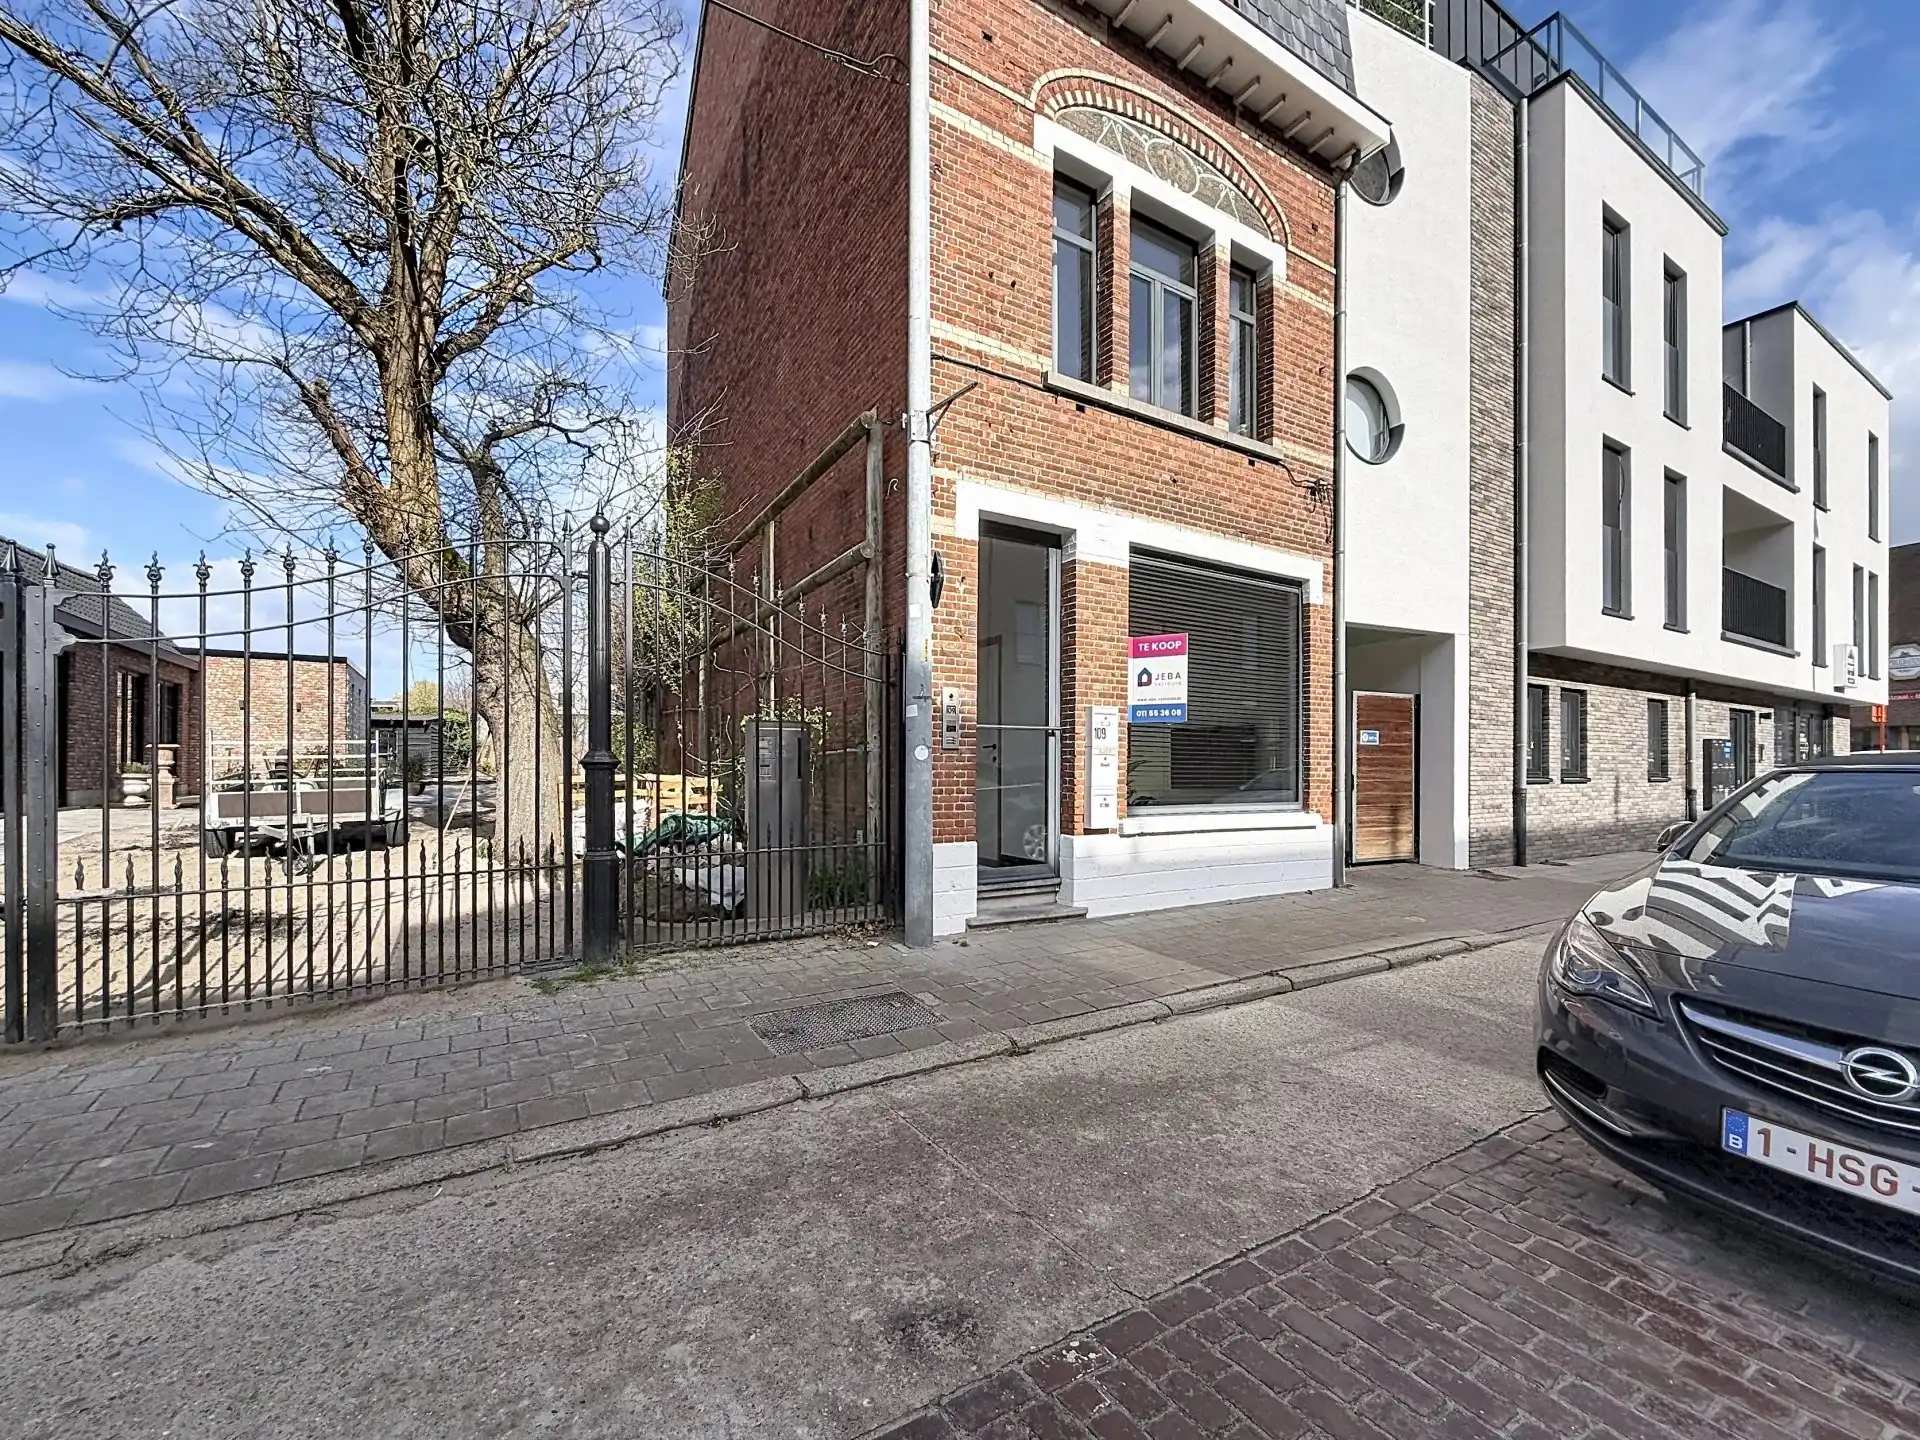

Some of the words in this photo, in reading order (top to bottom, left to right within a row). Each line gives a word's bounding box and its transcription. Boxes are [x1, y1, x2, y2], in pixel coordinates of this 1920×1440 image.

[1138, 643, 1150, 652] TE
[1151, 640, 1182, 651] KOOP
[1154, 672, 1182, 681] JEBA
[1094, 727, 1107, 740] 109
[1728, 1133, 1743, 1149] B
